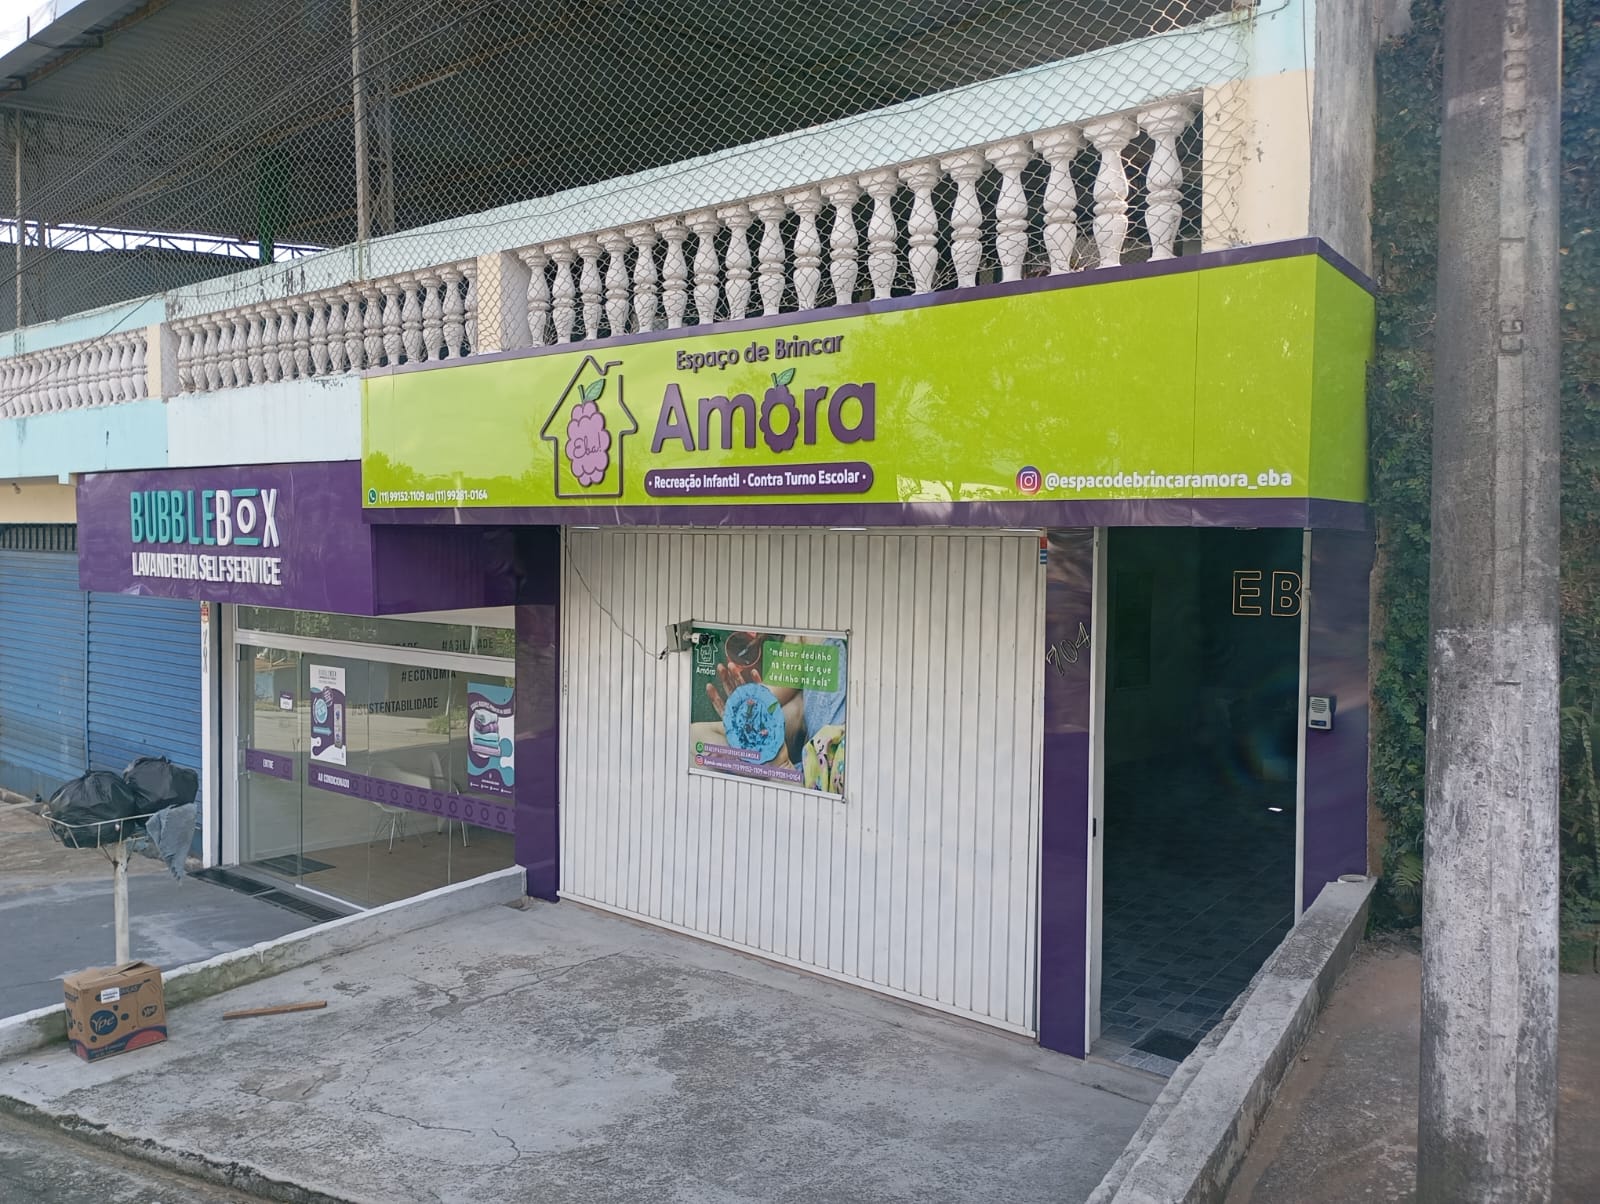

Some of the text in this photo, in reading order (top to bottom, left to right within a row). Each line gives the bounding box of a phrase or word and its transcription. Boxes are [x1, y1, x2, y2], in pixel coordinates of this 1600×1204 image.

[676, 335, 844, 373] Espaço de Brincar
[651, 382, 875, 453] Amora
[654, 469, 860, 491] Recreação Infantil Contra Turno Escolar
[1045, 469, 1293, 492] @espacodebrincaramora_eba
